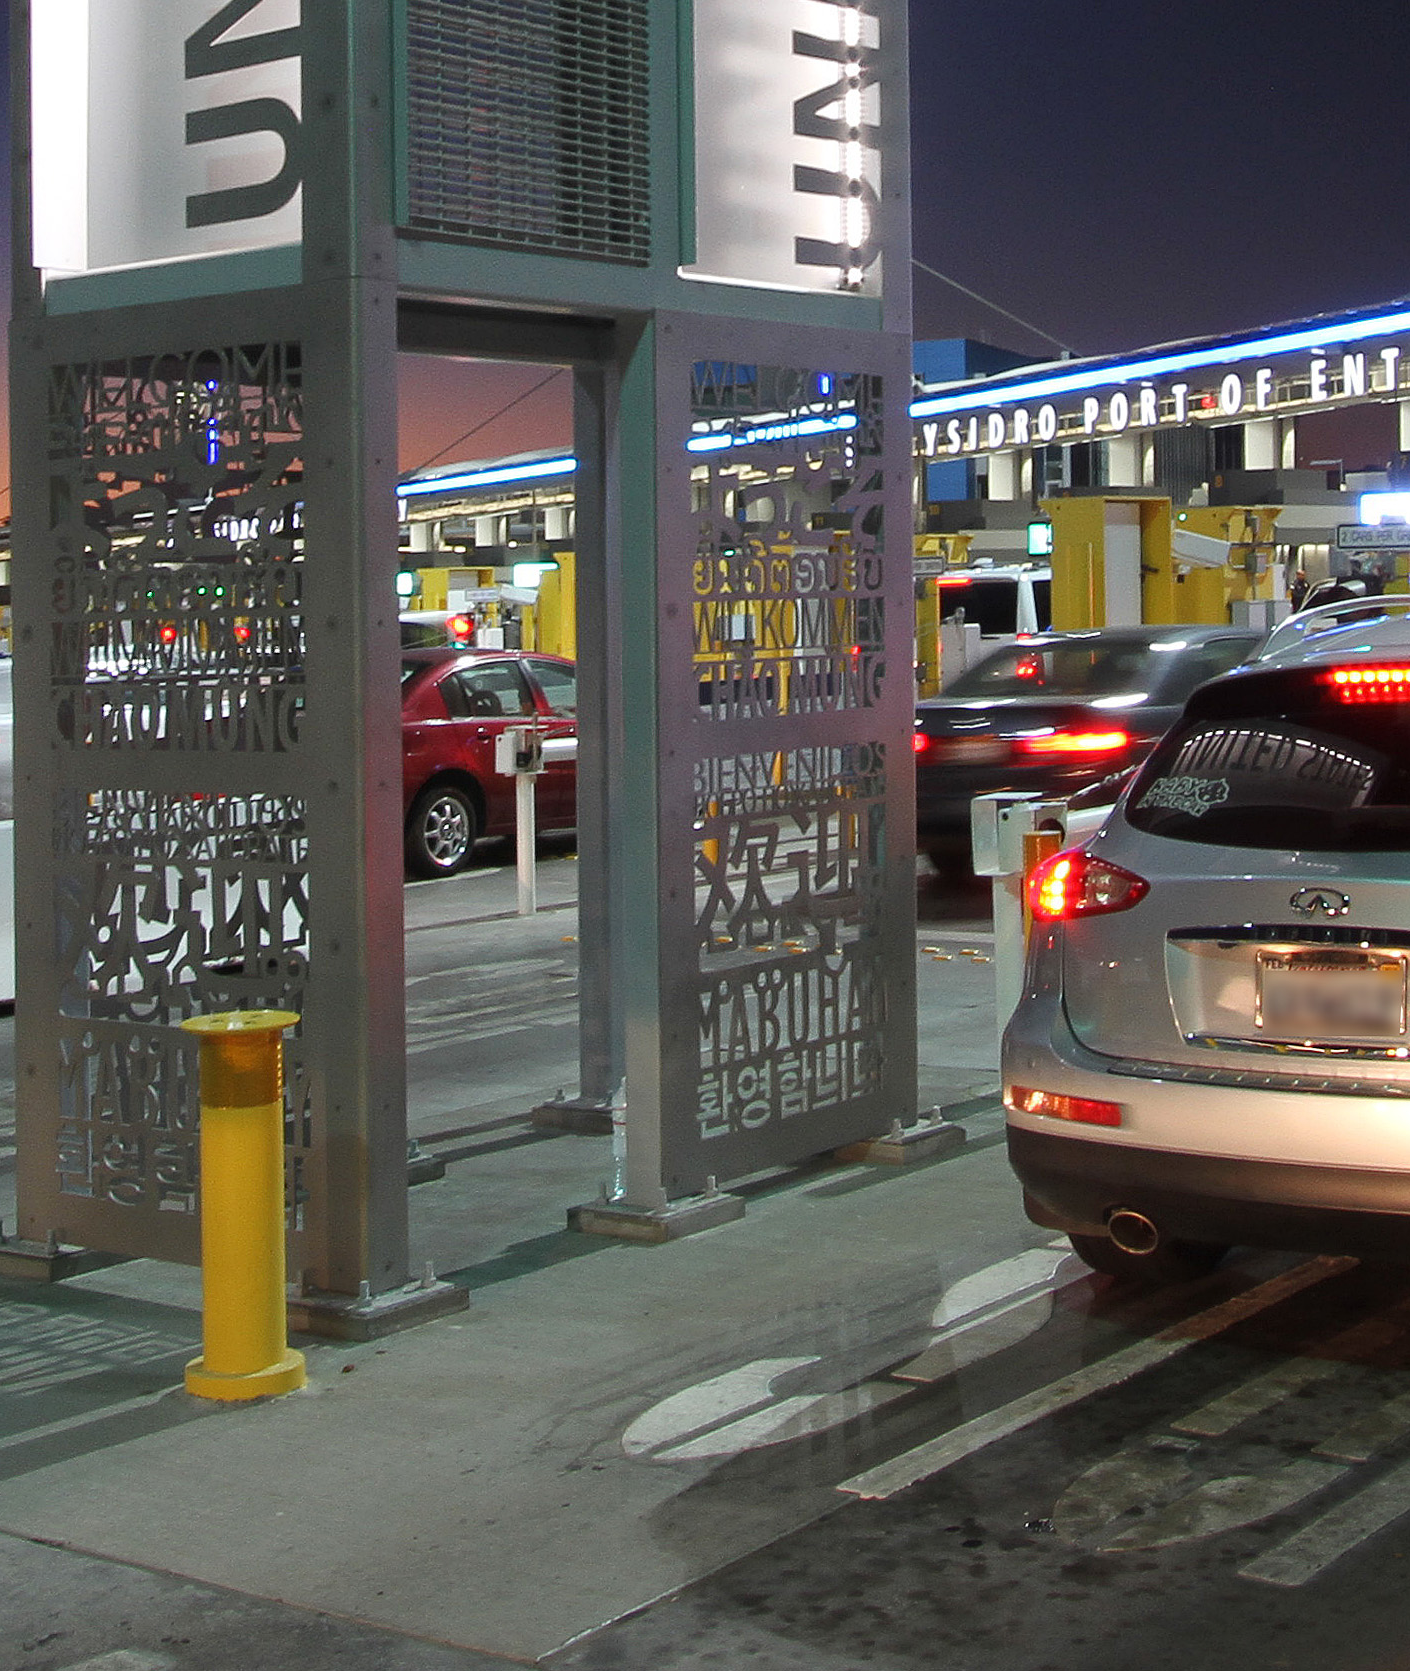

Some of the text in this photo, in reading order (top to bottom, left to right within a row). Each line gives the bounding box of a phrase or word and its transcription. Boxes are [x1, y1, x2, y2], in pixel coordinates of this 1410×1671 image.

[922, 403, 1058, 457] YSIDRO
[1083, 383, 1188, 434] PORT
[1221, 368, 1273, 417] OF
